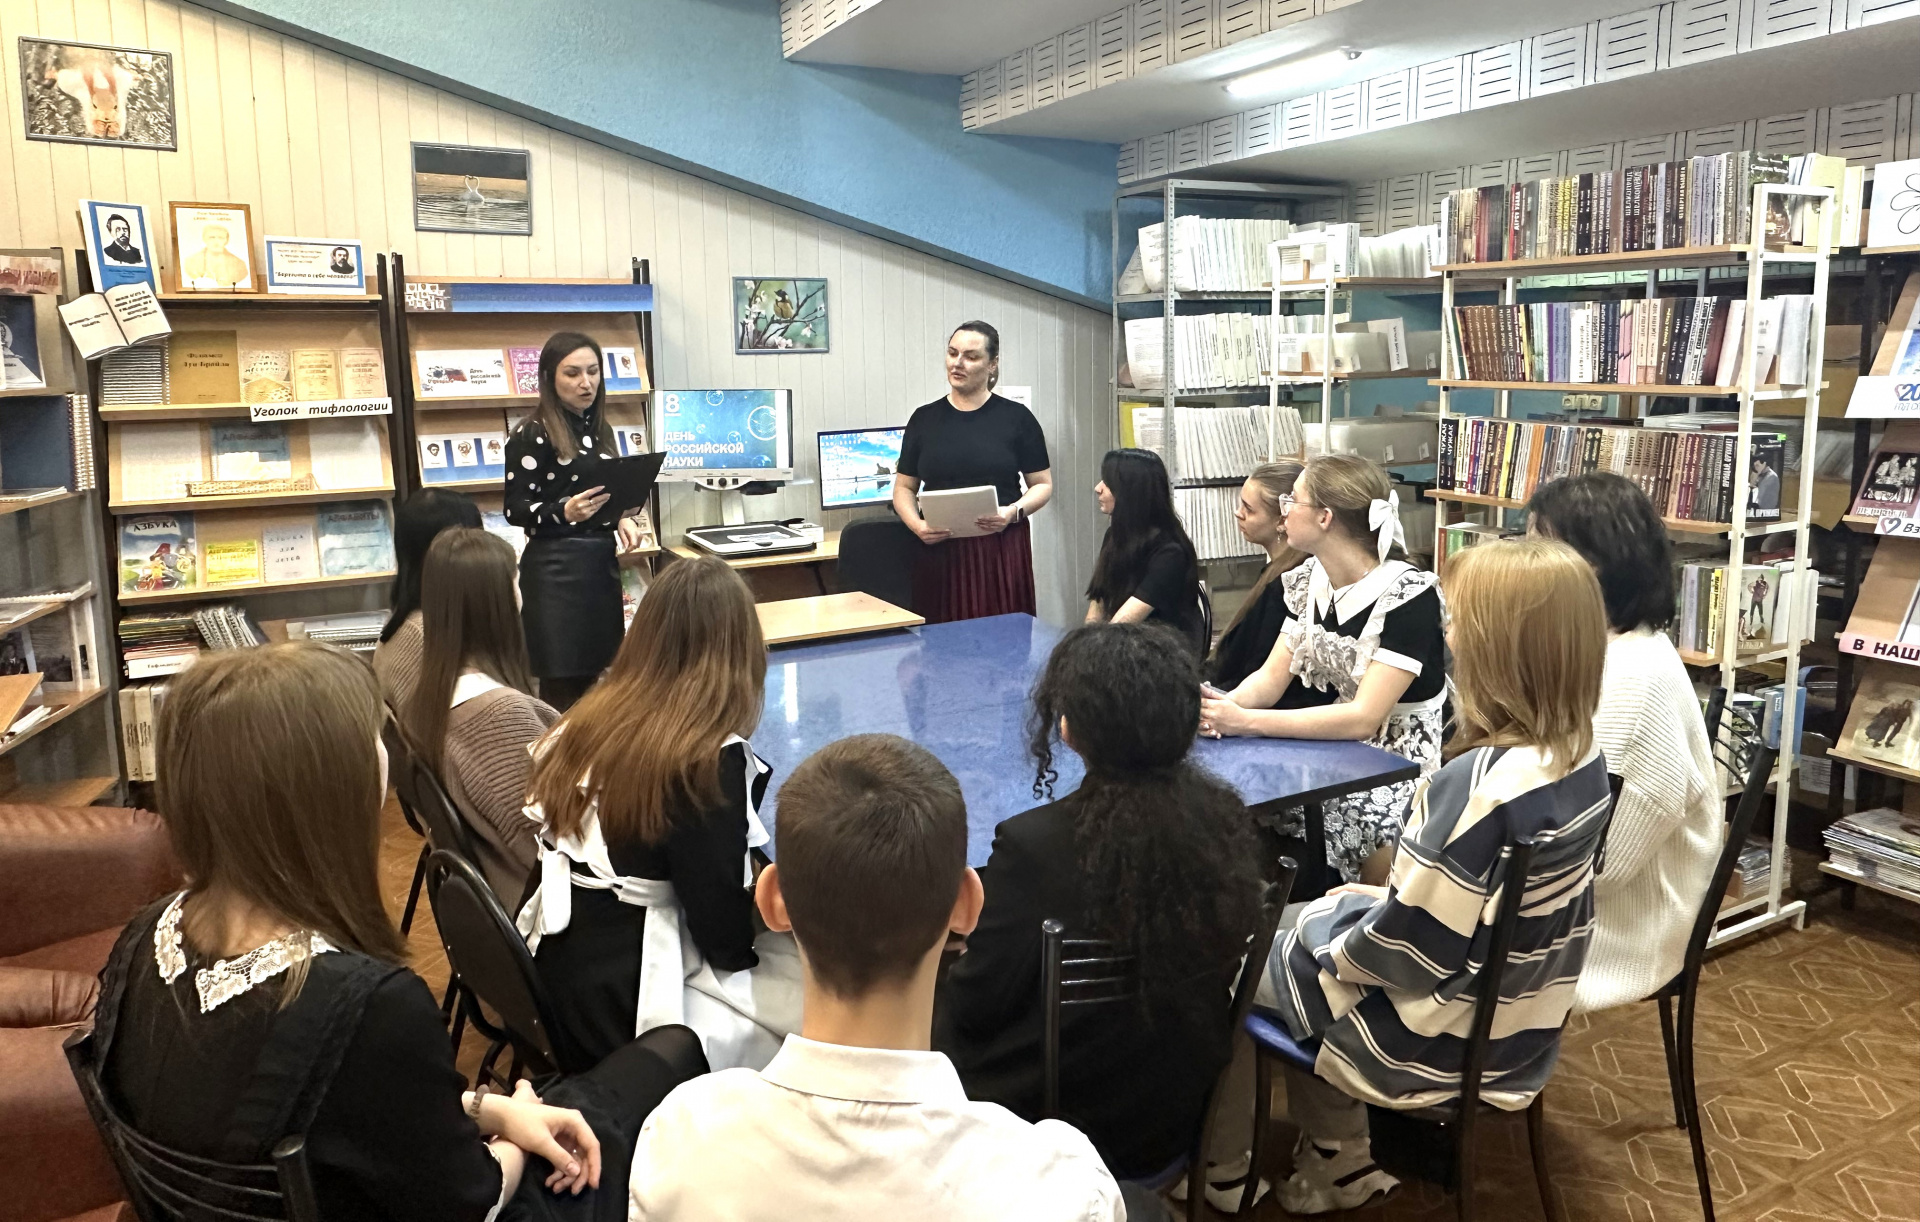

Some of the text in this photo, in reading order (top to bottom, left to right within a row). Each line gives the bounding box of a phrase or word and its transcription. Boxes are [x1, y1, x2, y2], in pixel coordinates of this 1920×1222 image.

[665, 393, 680, 413] 8
[253, 402, 389, 418] Уголок тифлологии
[664, 431, 696, 443] ДЕНЬ
[1440, 423, 1448, 454] ЧУЖАК
[664, 442, 745, 454] РОССИЙСКОЙ
[663, 456, 704, 467] НАУКИ
[133, 520, 177, 532] АЗБУКА
[1853, 638, 1865, 651] В
